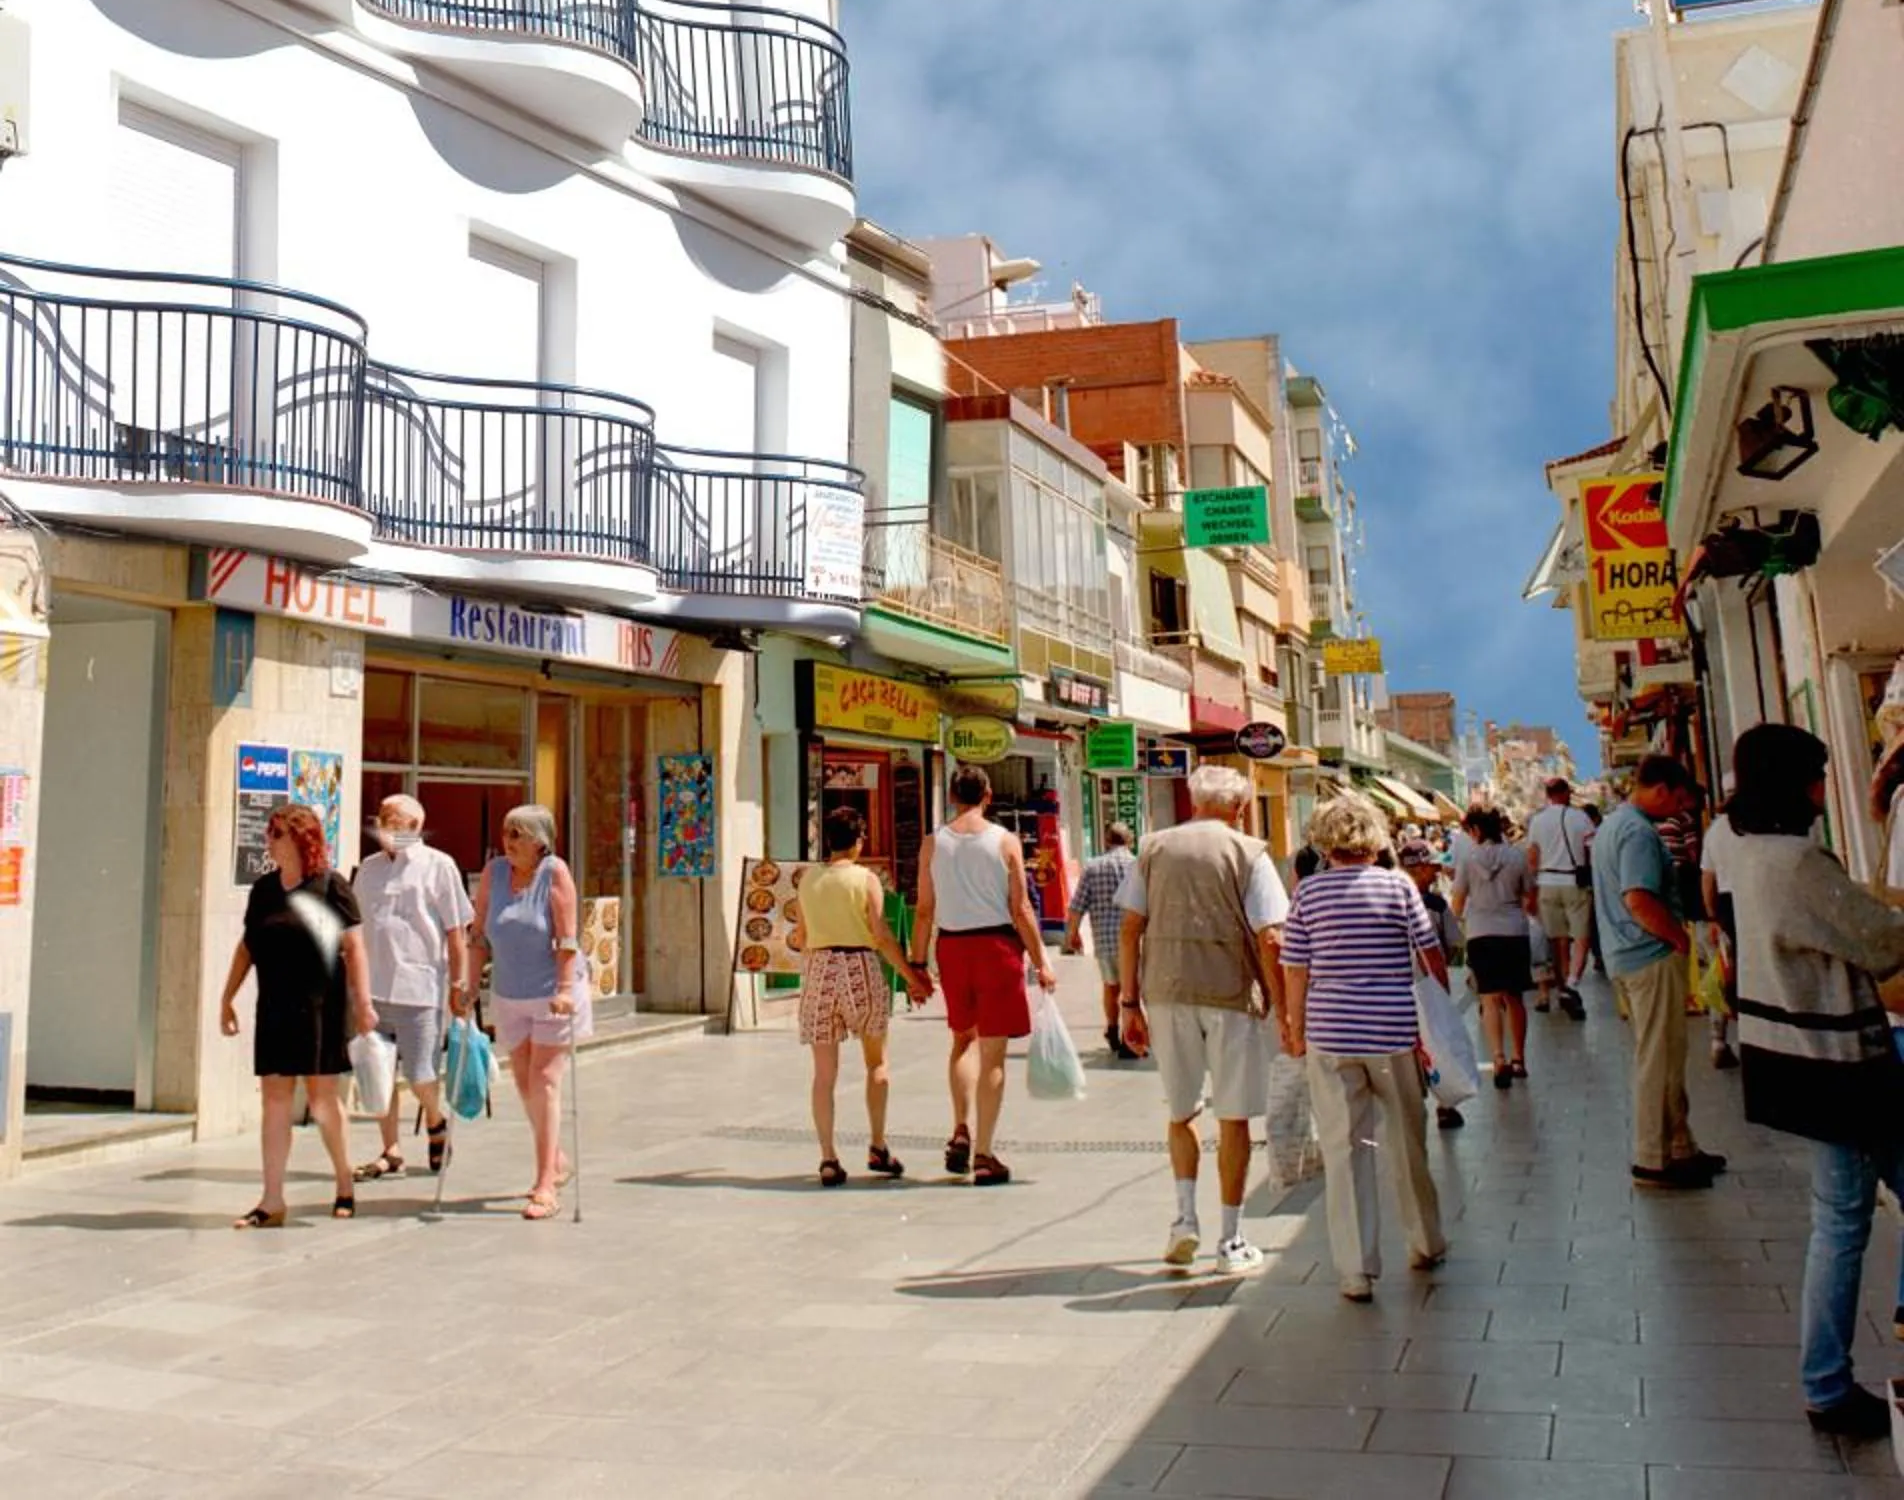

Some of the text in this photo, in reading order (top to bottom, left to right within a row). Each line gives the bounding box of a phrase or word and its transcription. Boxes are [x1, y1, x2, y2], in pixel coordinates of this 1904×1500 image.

[264, 555, 654, 668] HOTEL Restaurant IRIS
[1591, 555, 1606, 595] 1
